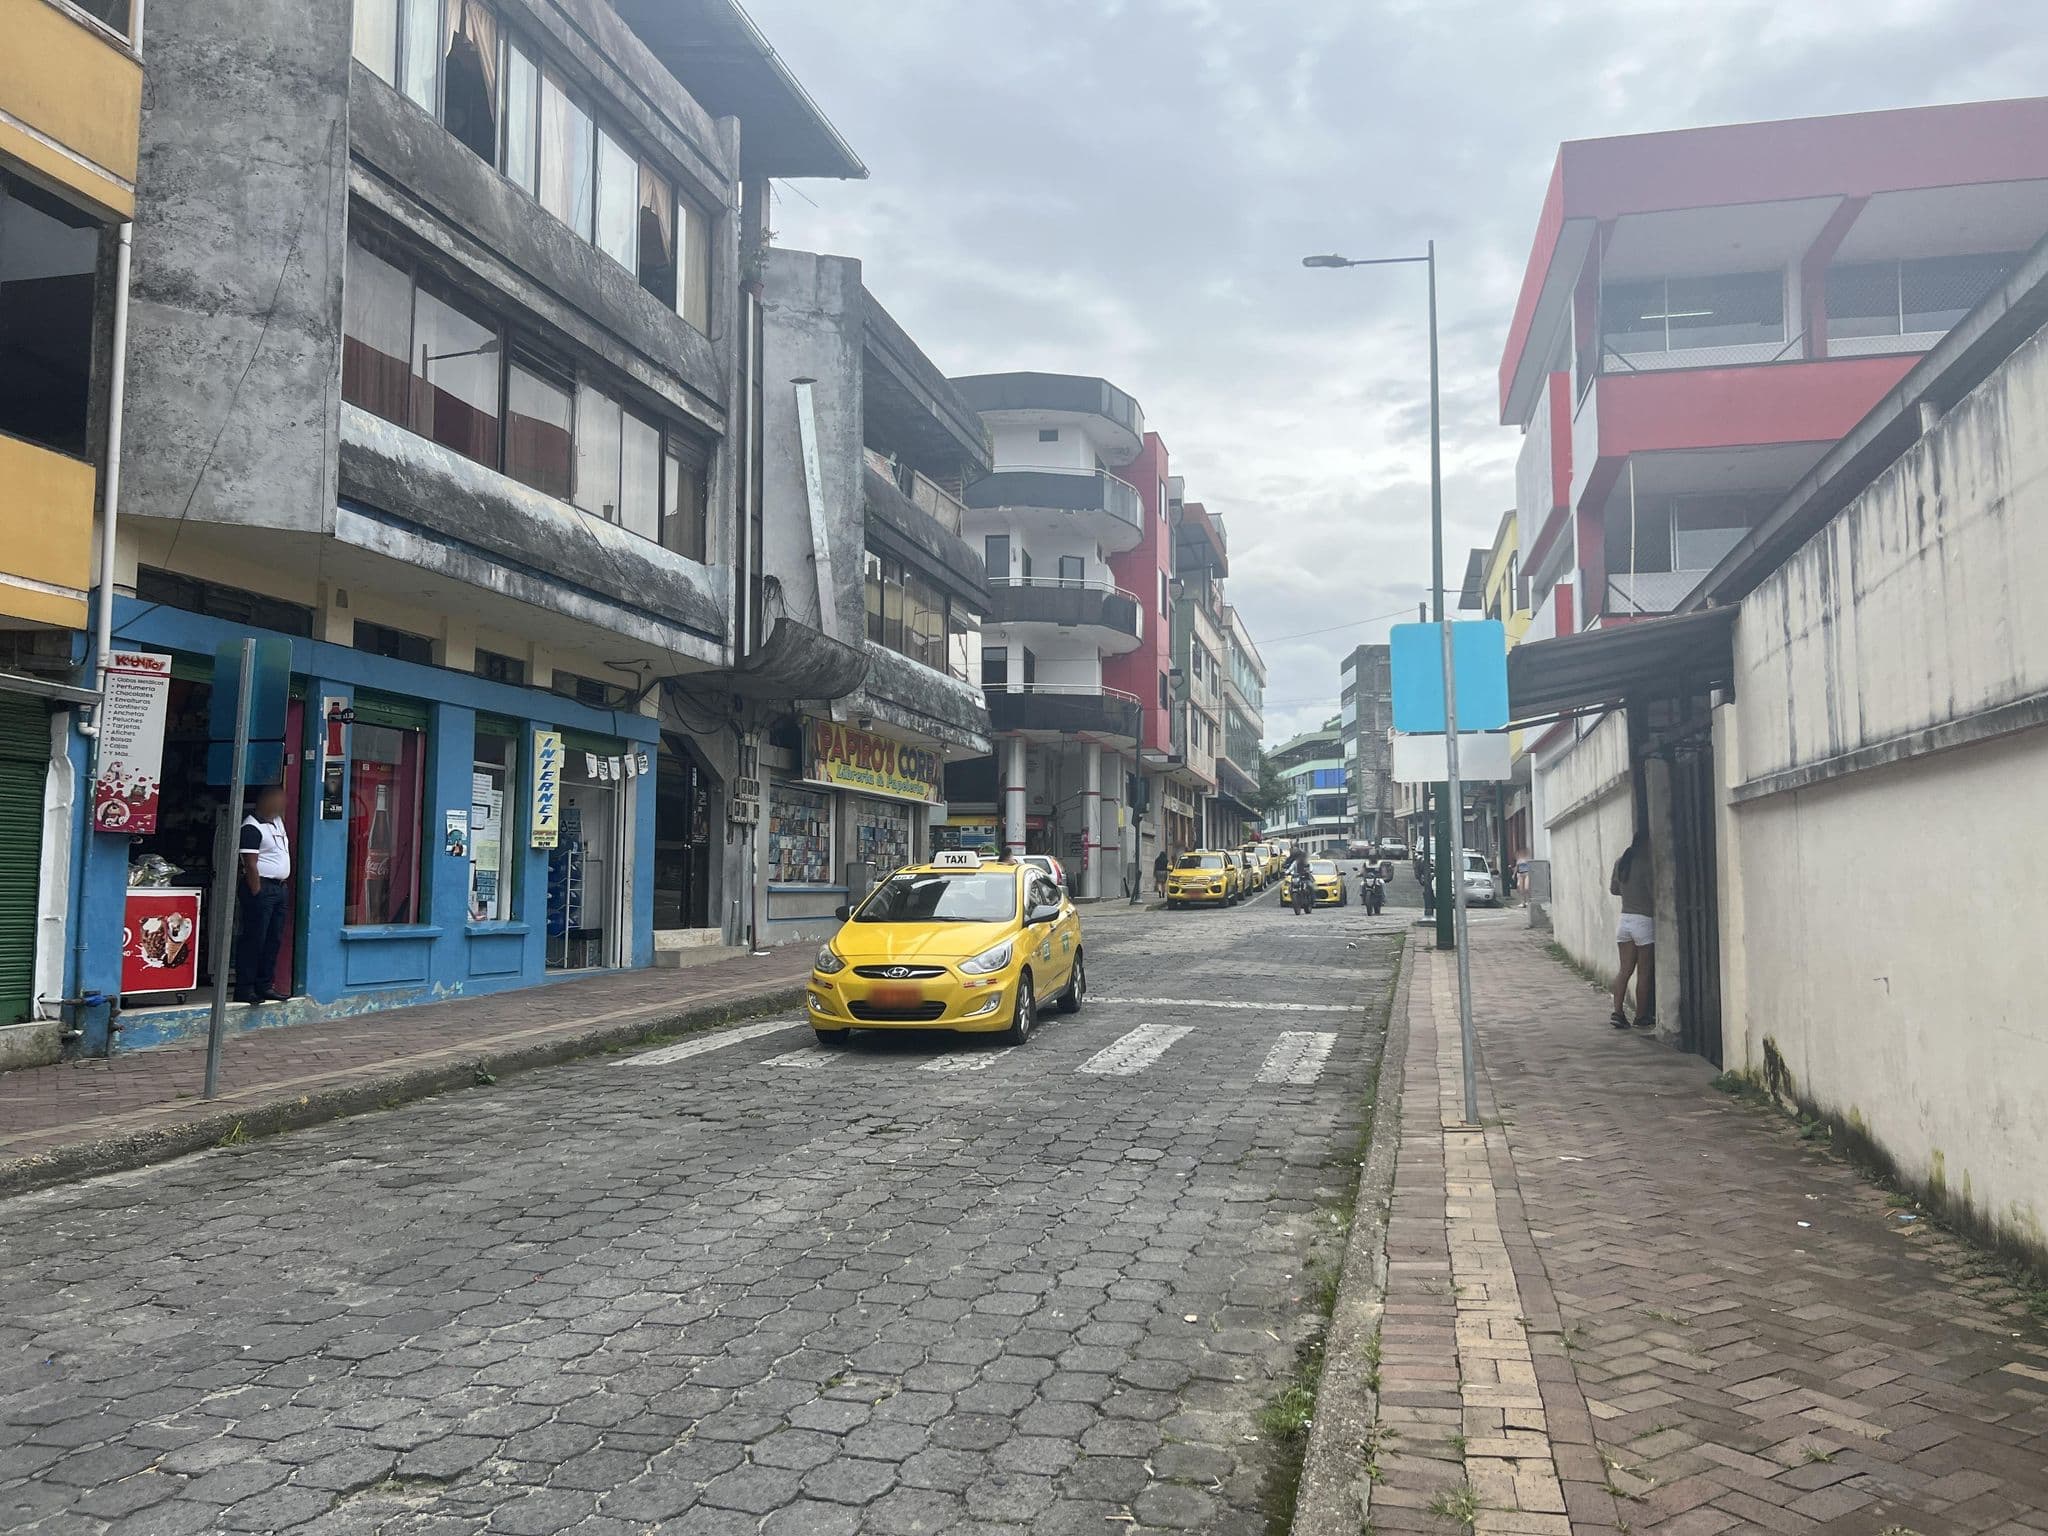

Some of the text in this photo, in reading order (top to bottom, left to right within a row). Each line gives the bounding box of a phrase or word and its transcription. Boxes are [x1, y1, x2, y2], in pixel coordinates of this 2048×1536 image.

[115, 690, 153, 698] Chocolates
[112, 722, 141, 730] Tarjetas
[537, 737, 556, 825] INTERNET
[944, 855, 967, 864] TAXI
